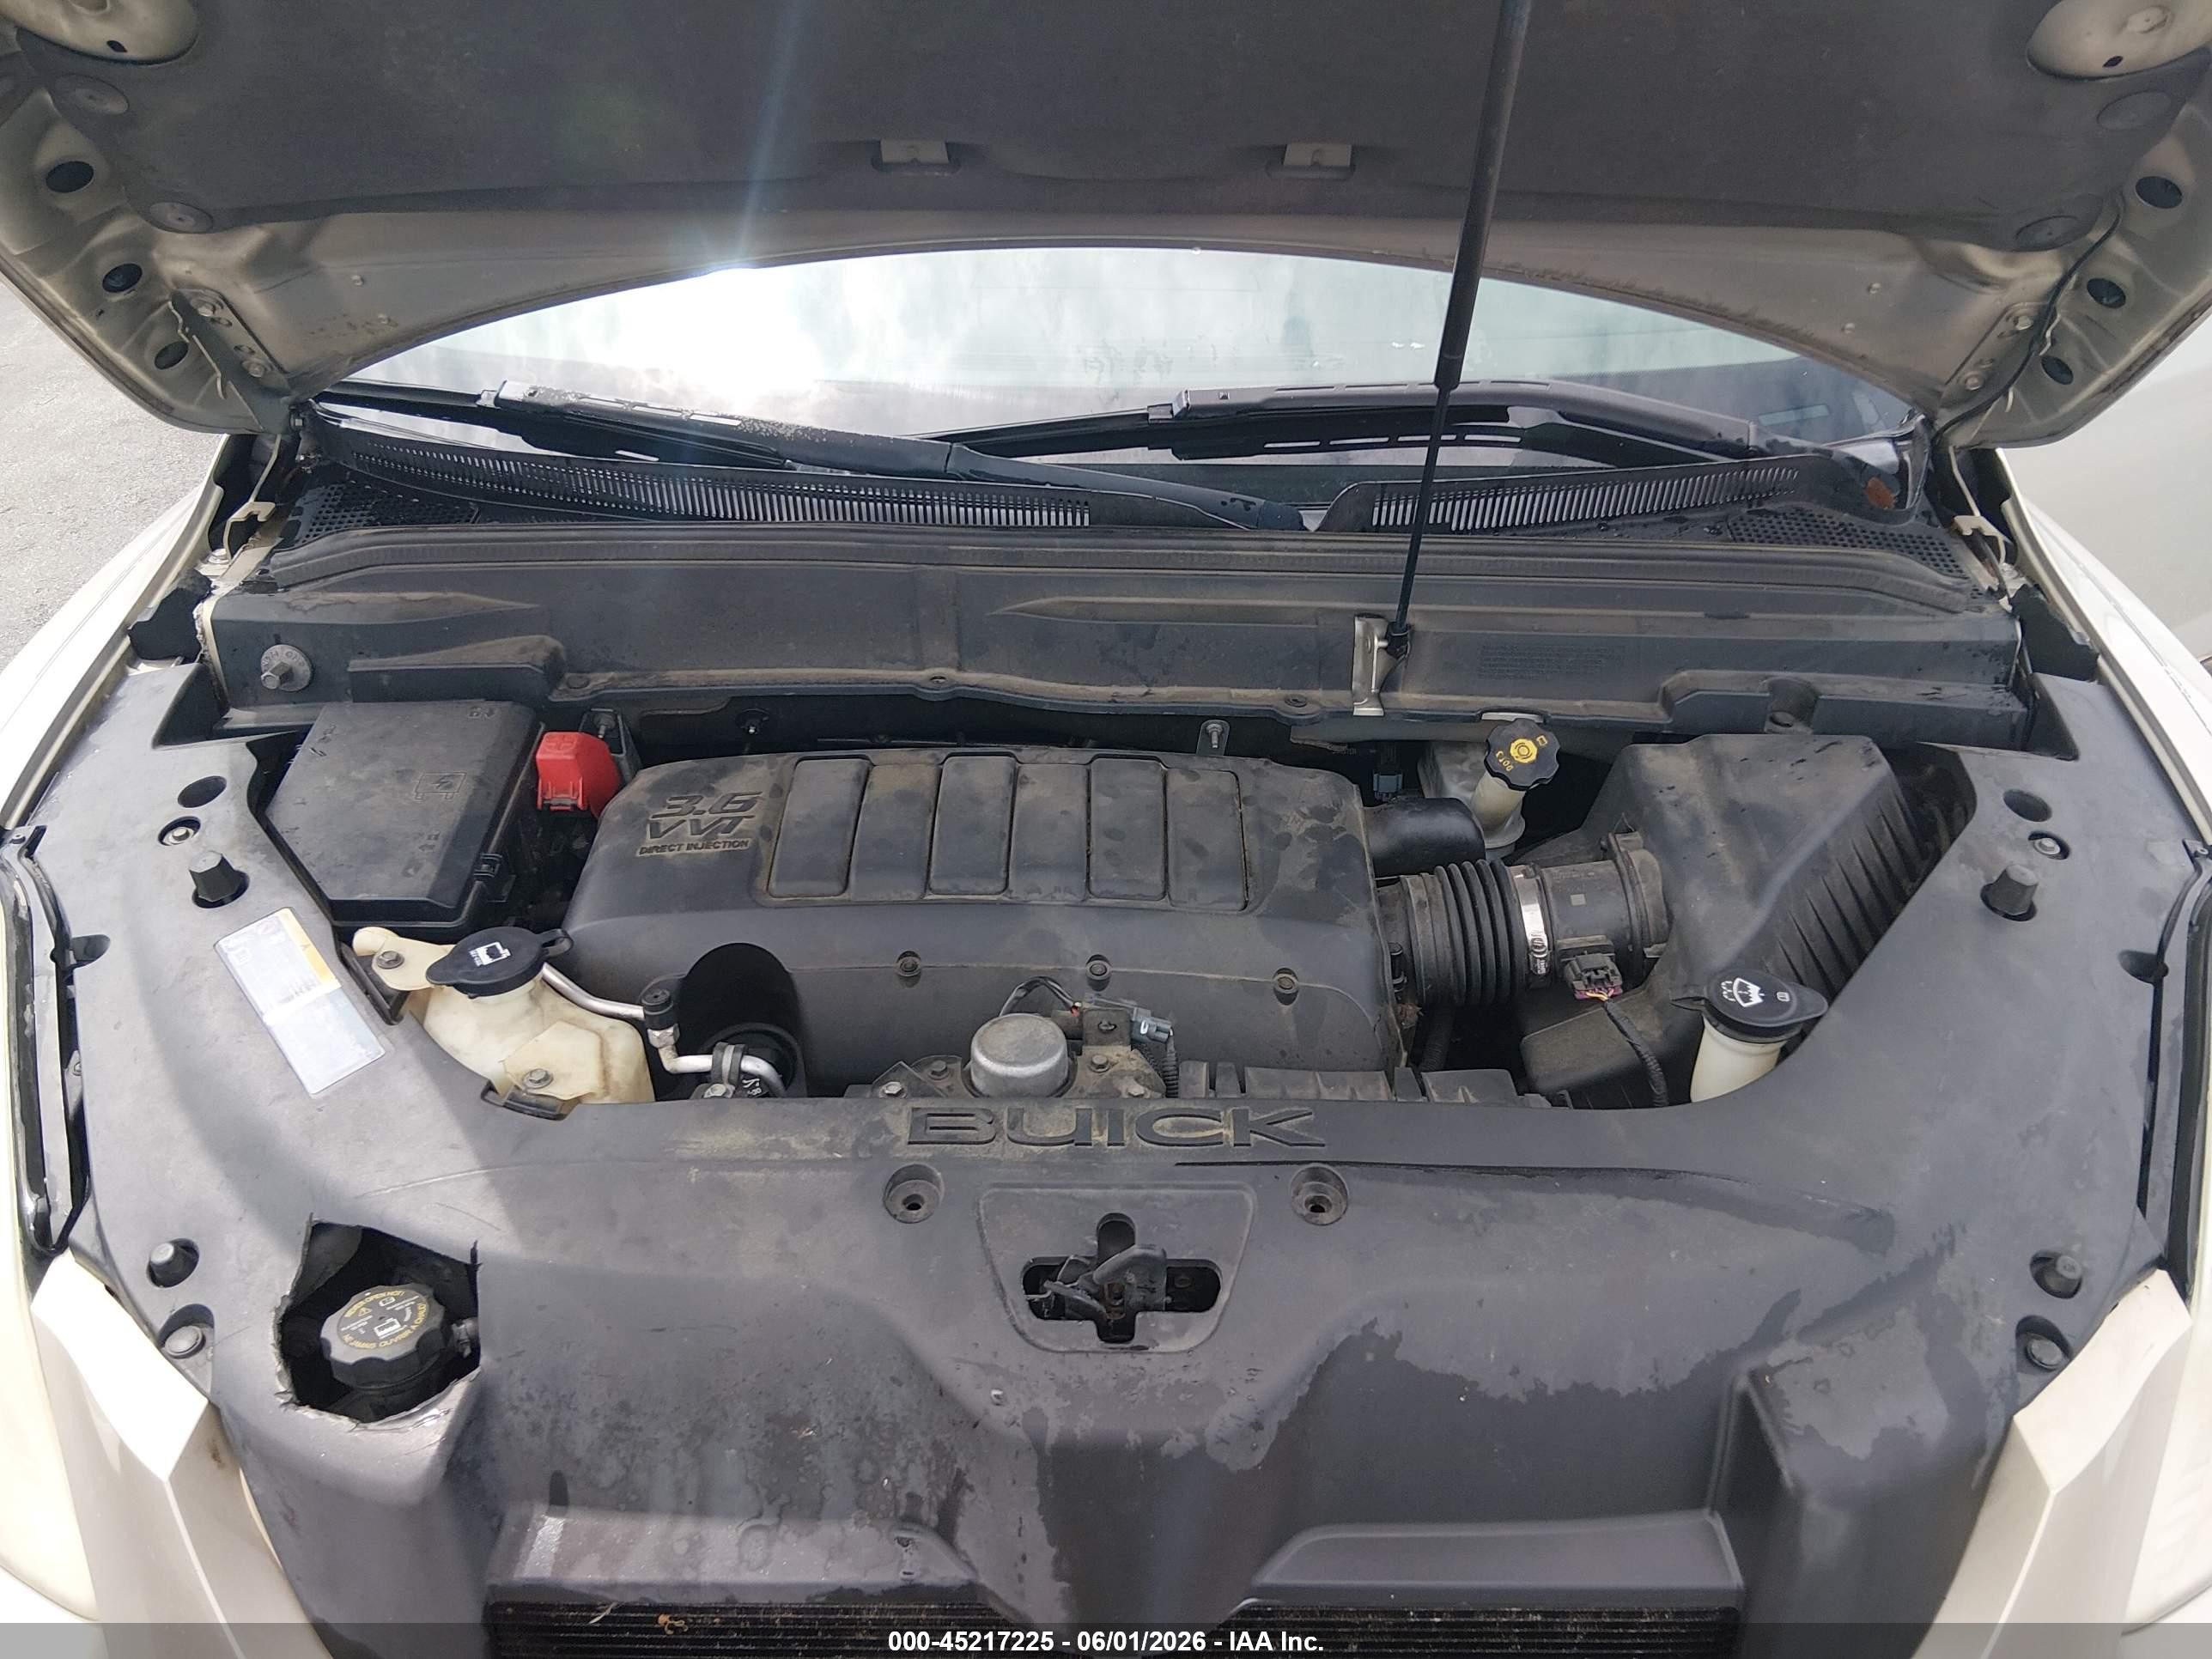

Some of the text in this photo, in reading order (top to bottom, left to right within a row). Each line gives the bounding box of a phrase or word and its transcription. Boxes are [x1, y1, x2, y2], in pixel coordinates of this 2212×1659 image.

[650, 791, 763, 819] 3.6
[648, 814, 756, 840] VVT
[638, 839, 750, 856] DIRECT INJECTION
[907, 1106, 1326, 1147] BUICK
